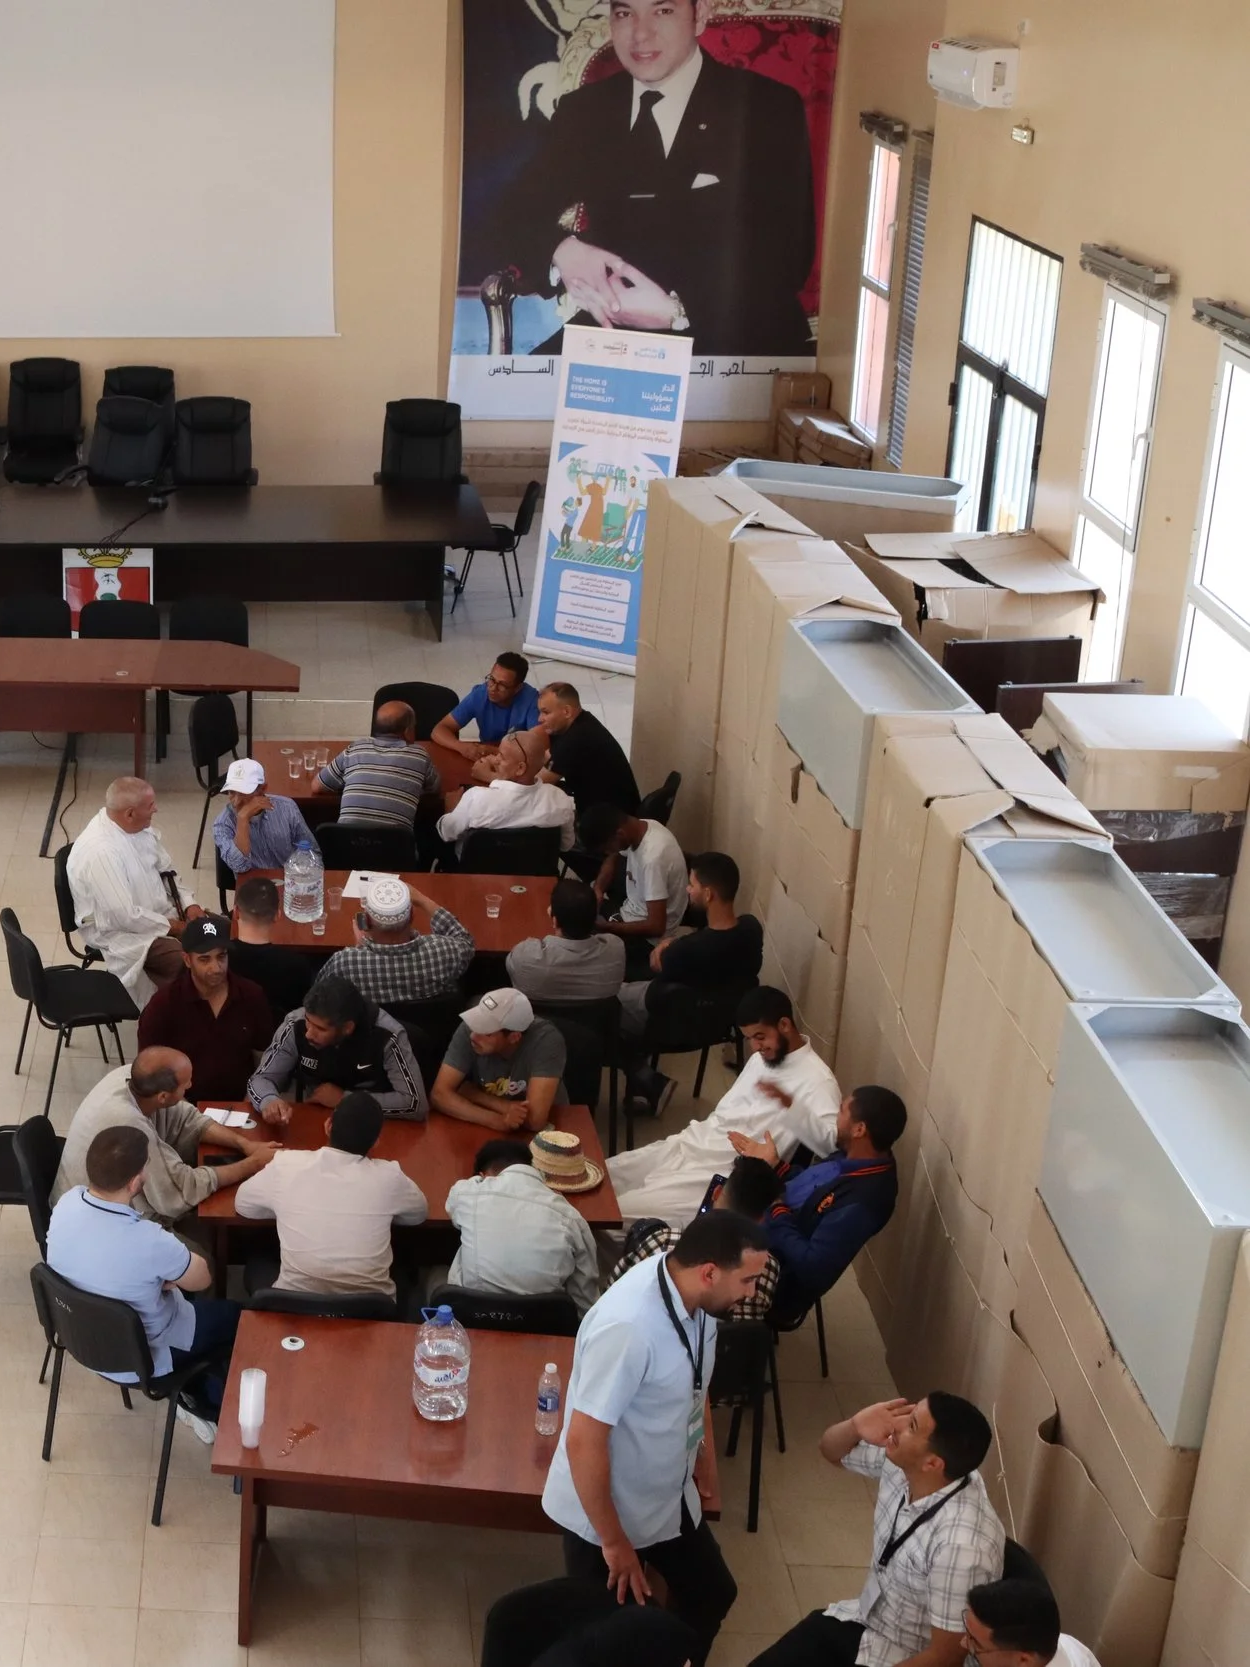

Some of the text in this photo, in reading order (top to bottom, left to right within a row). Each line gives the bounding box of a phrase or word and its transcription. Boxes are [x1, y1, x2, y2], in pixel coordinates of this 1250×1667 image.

[488, 359, 554, 377] السادس
[572, 375, 583, 384] THE
[584, 377, 600, 386] HOME
[570, 392, 614, 404] RESPONSIBILITY
